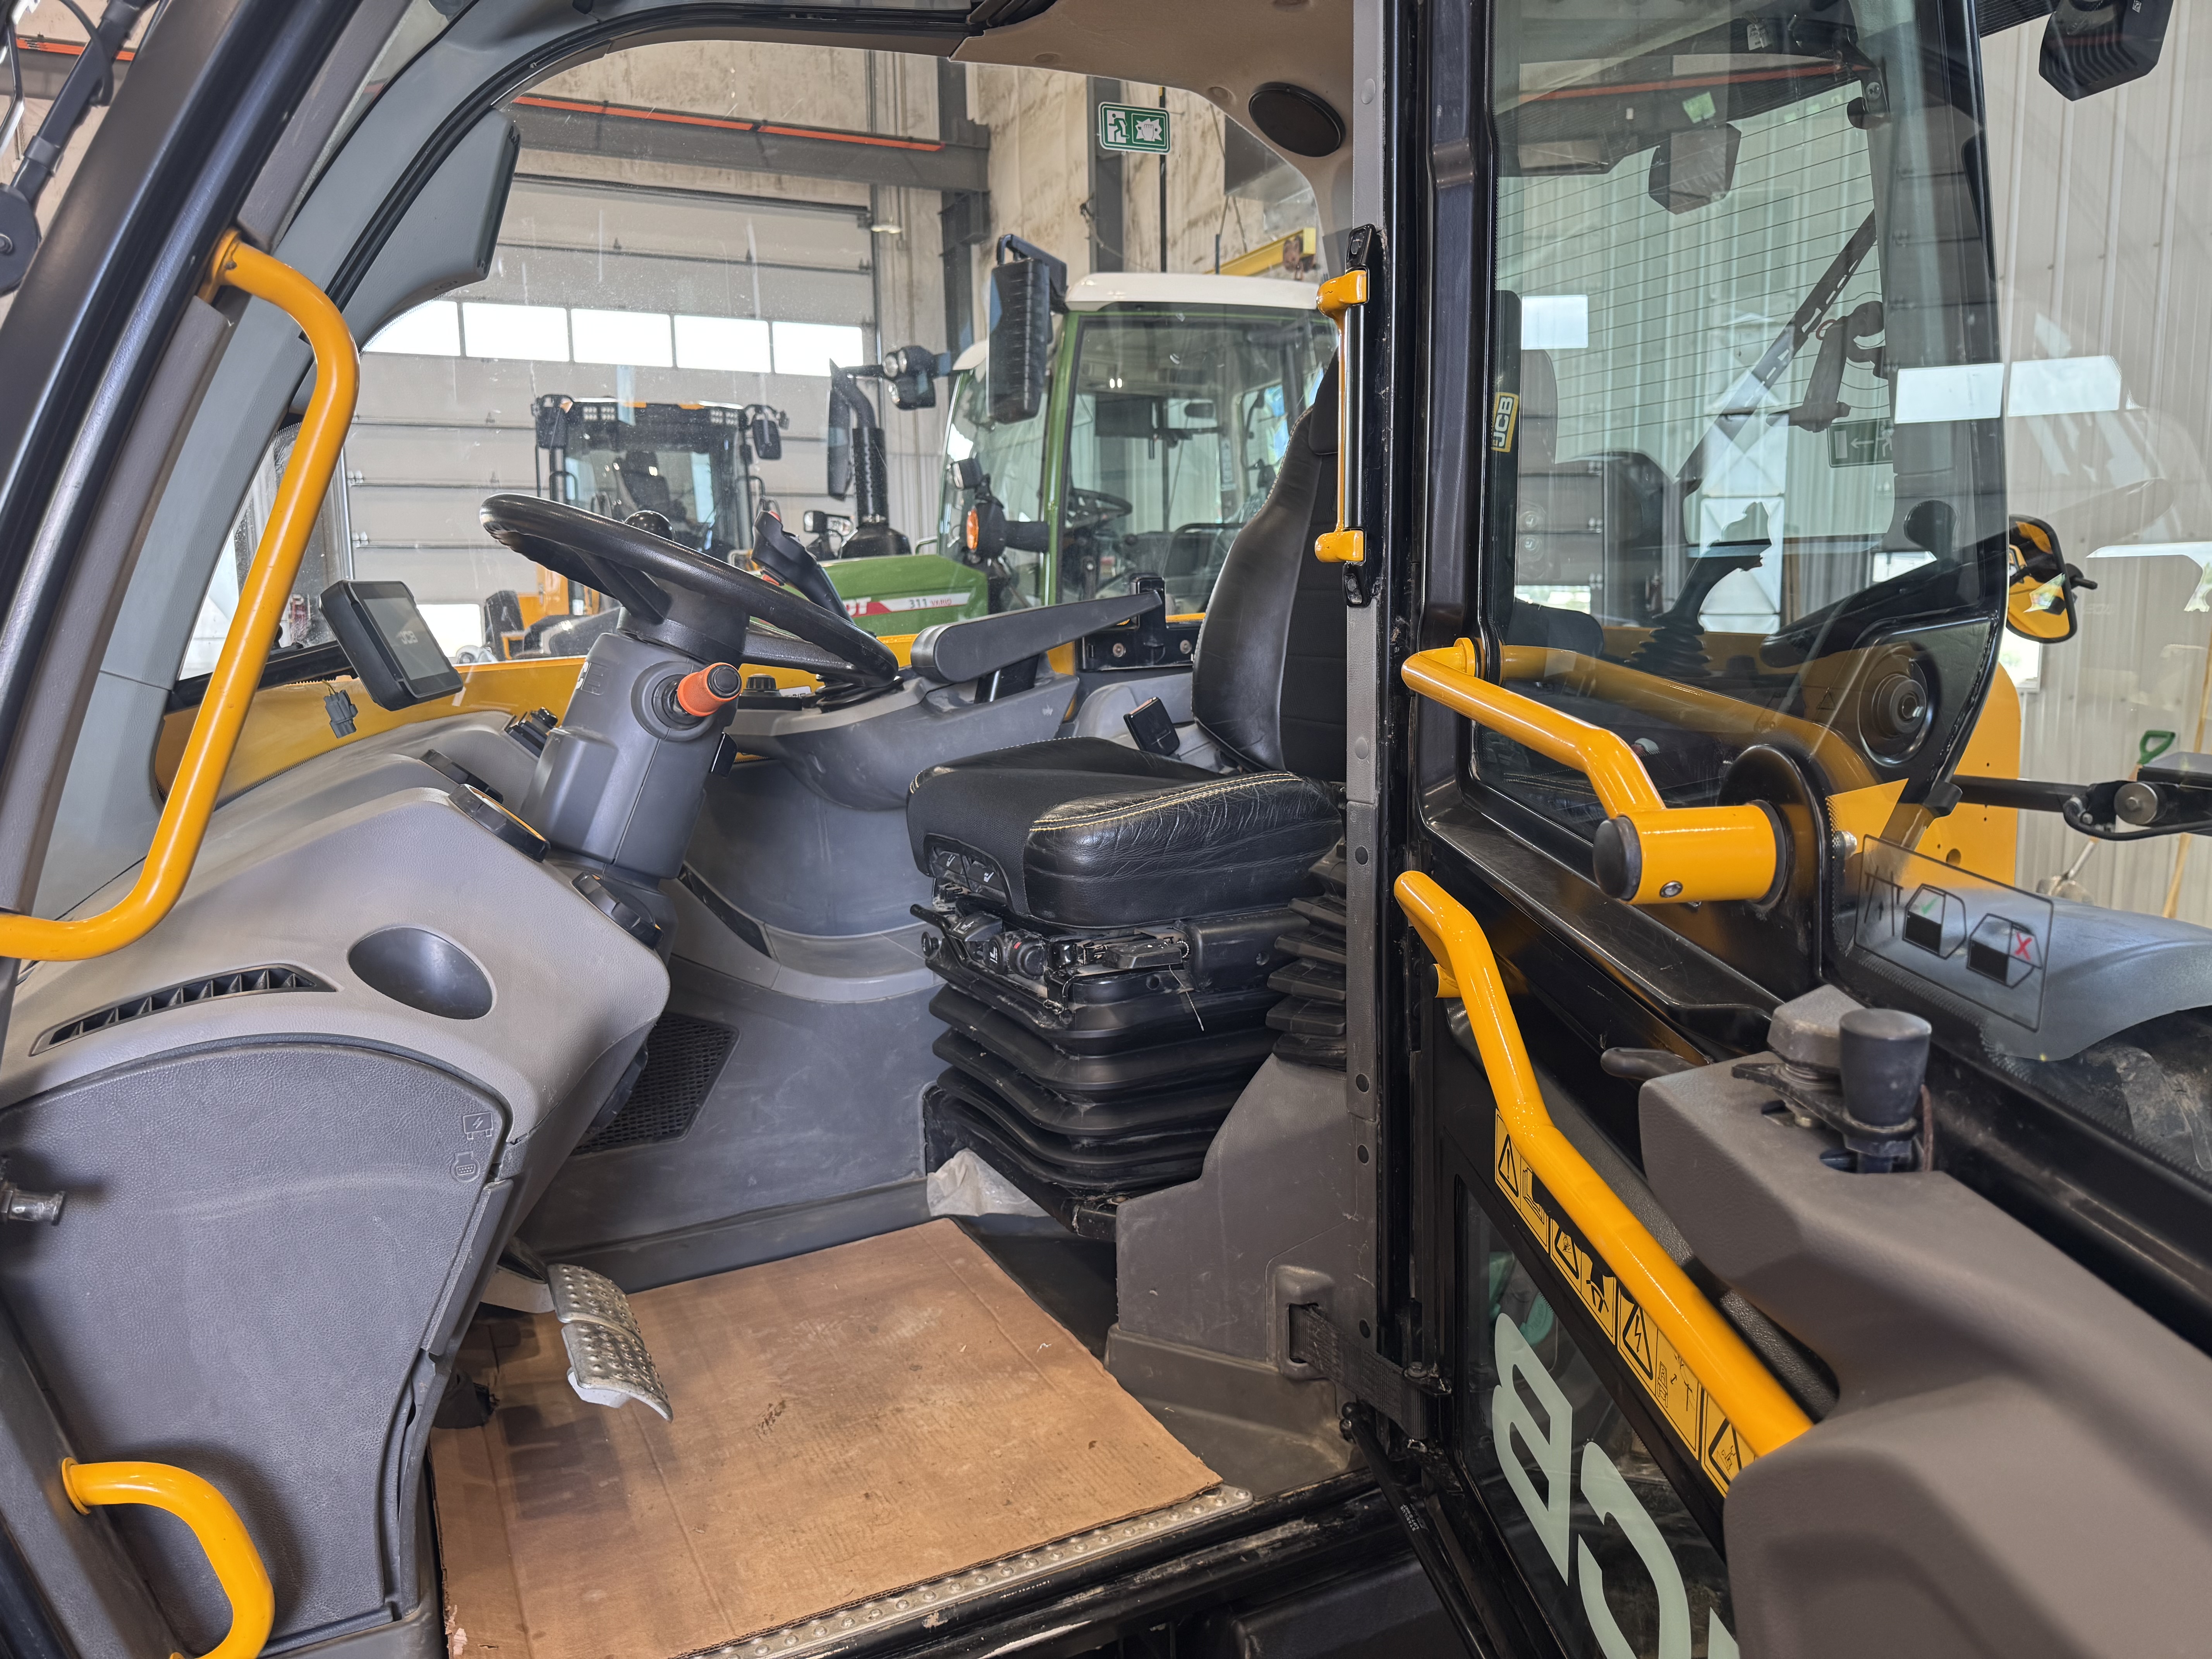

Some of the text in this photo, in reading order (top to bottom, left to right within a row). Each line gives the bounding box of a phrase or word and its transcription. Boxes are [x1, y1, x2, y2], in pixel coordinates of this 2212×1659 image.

[1493, 397, 1514, 447] JCB
[909, 598, 927, 609] 311
[931, 598, 952, 606] VARIO
[399, 630, 419, 645] JCB
[1400, 1506, 1416, 1532] STABILUS
